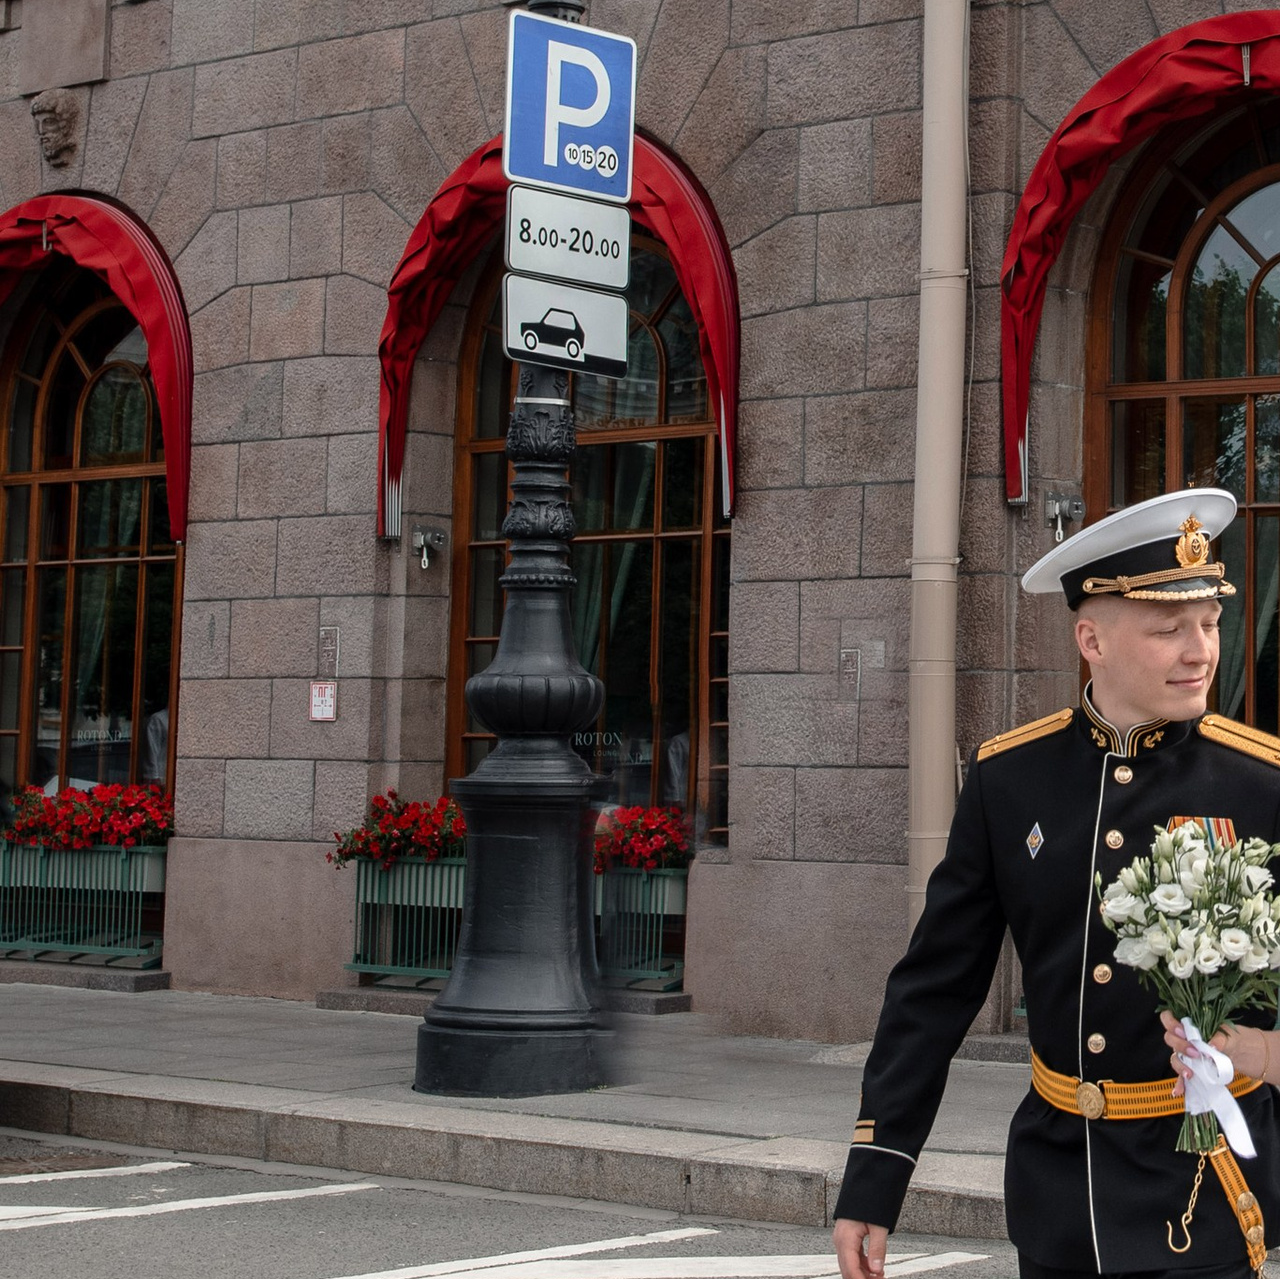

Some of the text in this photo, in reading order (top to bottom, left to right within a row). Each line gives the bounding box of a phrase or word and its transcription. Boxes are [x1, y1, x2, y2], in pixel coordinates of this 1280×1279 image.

[544, 40, 611, 167] P
[568, 148, 617, 170] 10 15 20
[519, 218, 620, 259] 8.00-20.00
[77, 730, 129, 742] ROTOND
